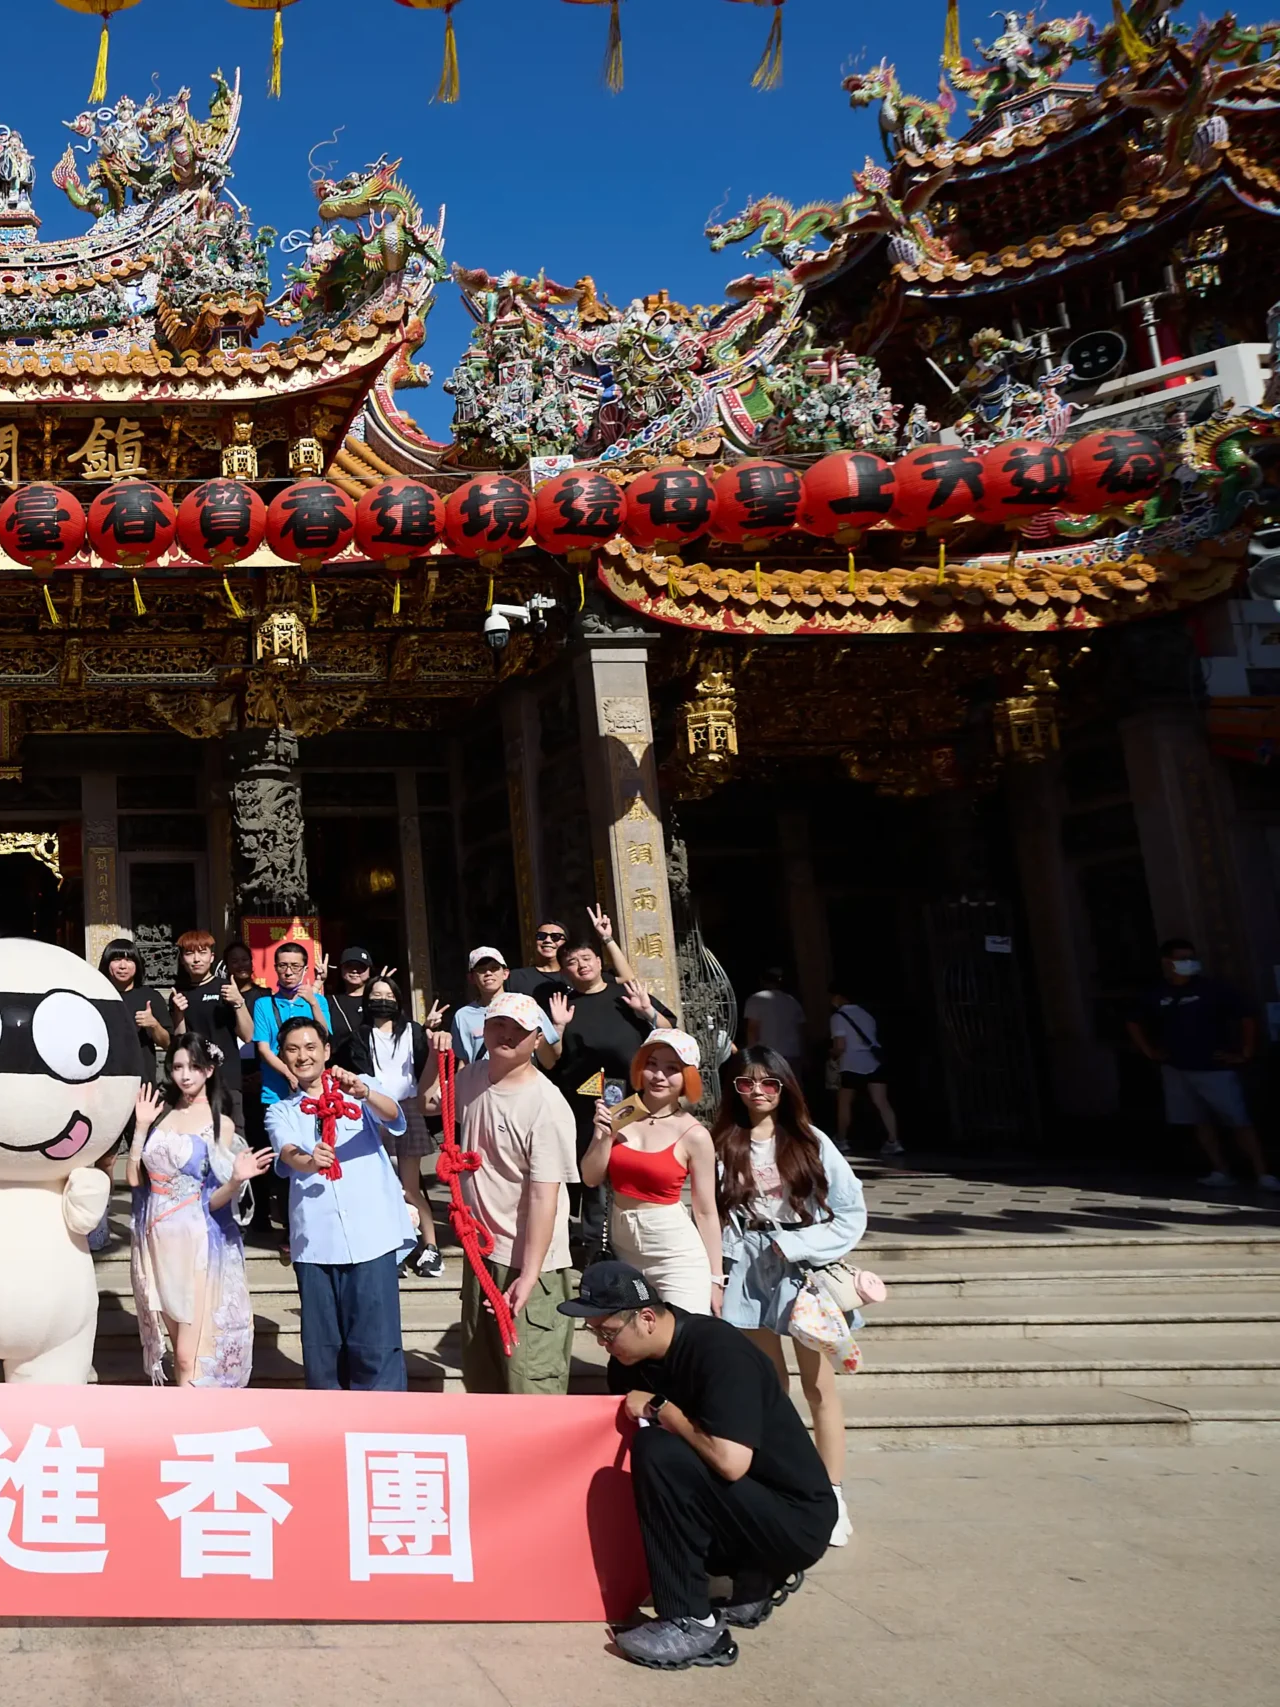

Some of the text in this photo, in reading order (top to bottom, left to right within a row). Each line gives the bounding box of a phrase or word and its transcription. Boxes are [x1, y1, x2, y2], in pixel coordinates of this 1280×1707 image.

[626, 795, 665, 960] 風調雨順
[269, 926, 311, 941] 歡迎
